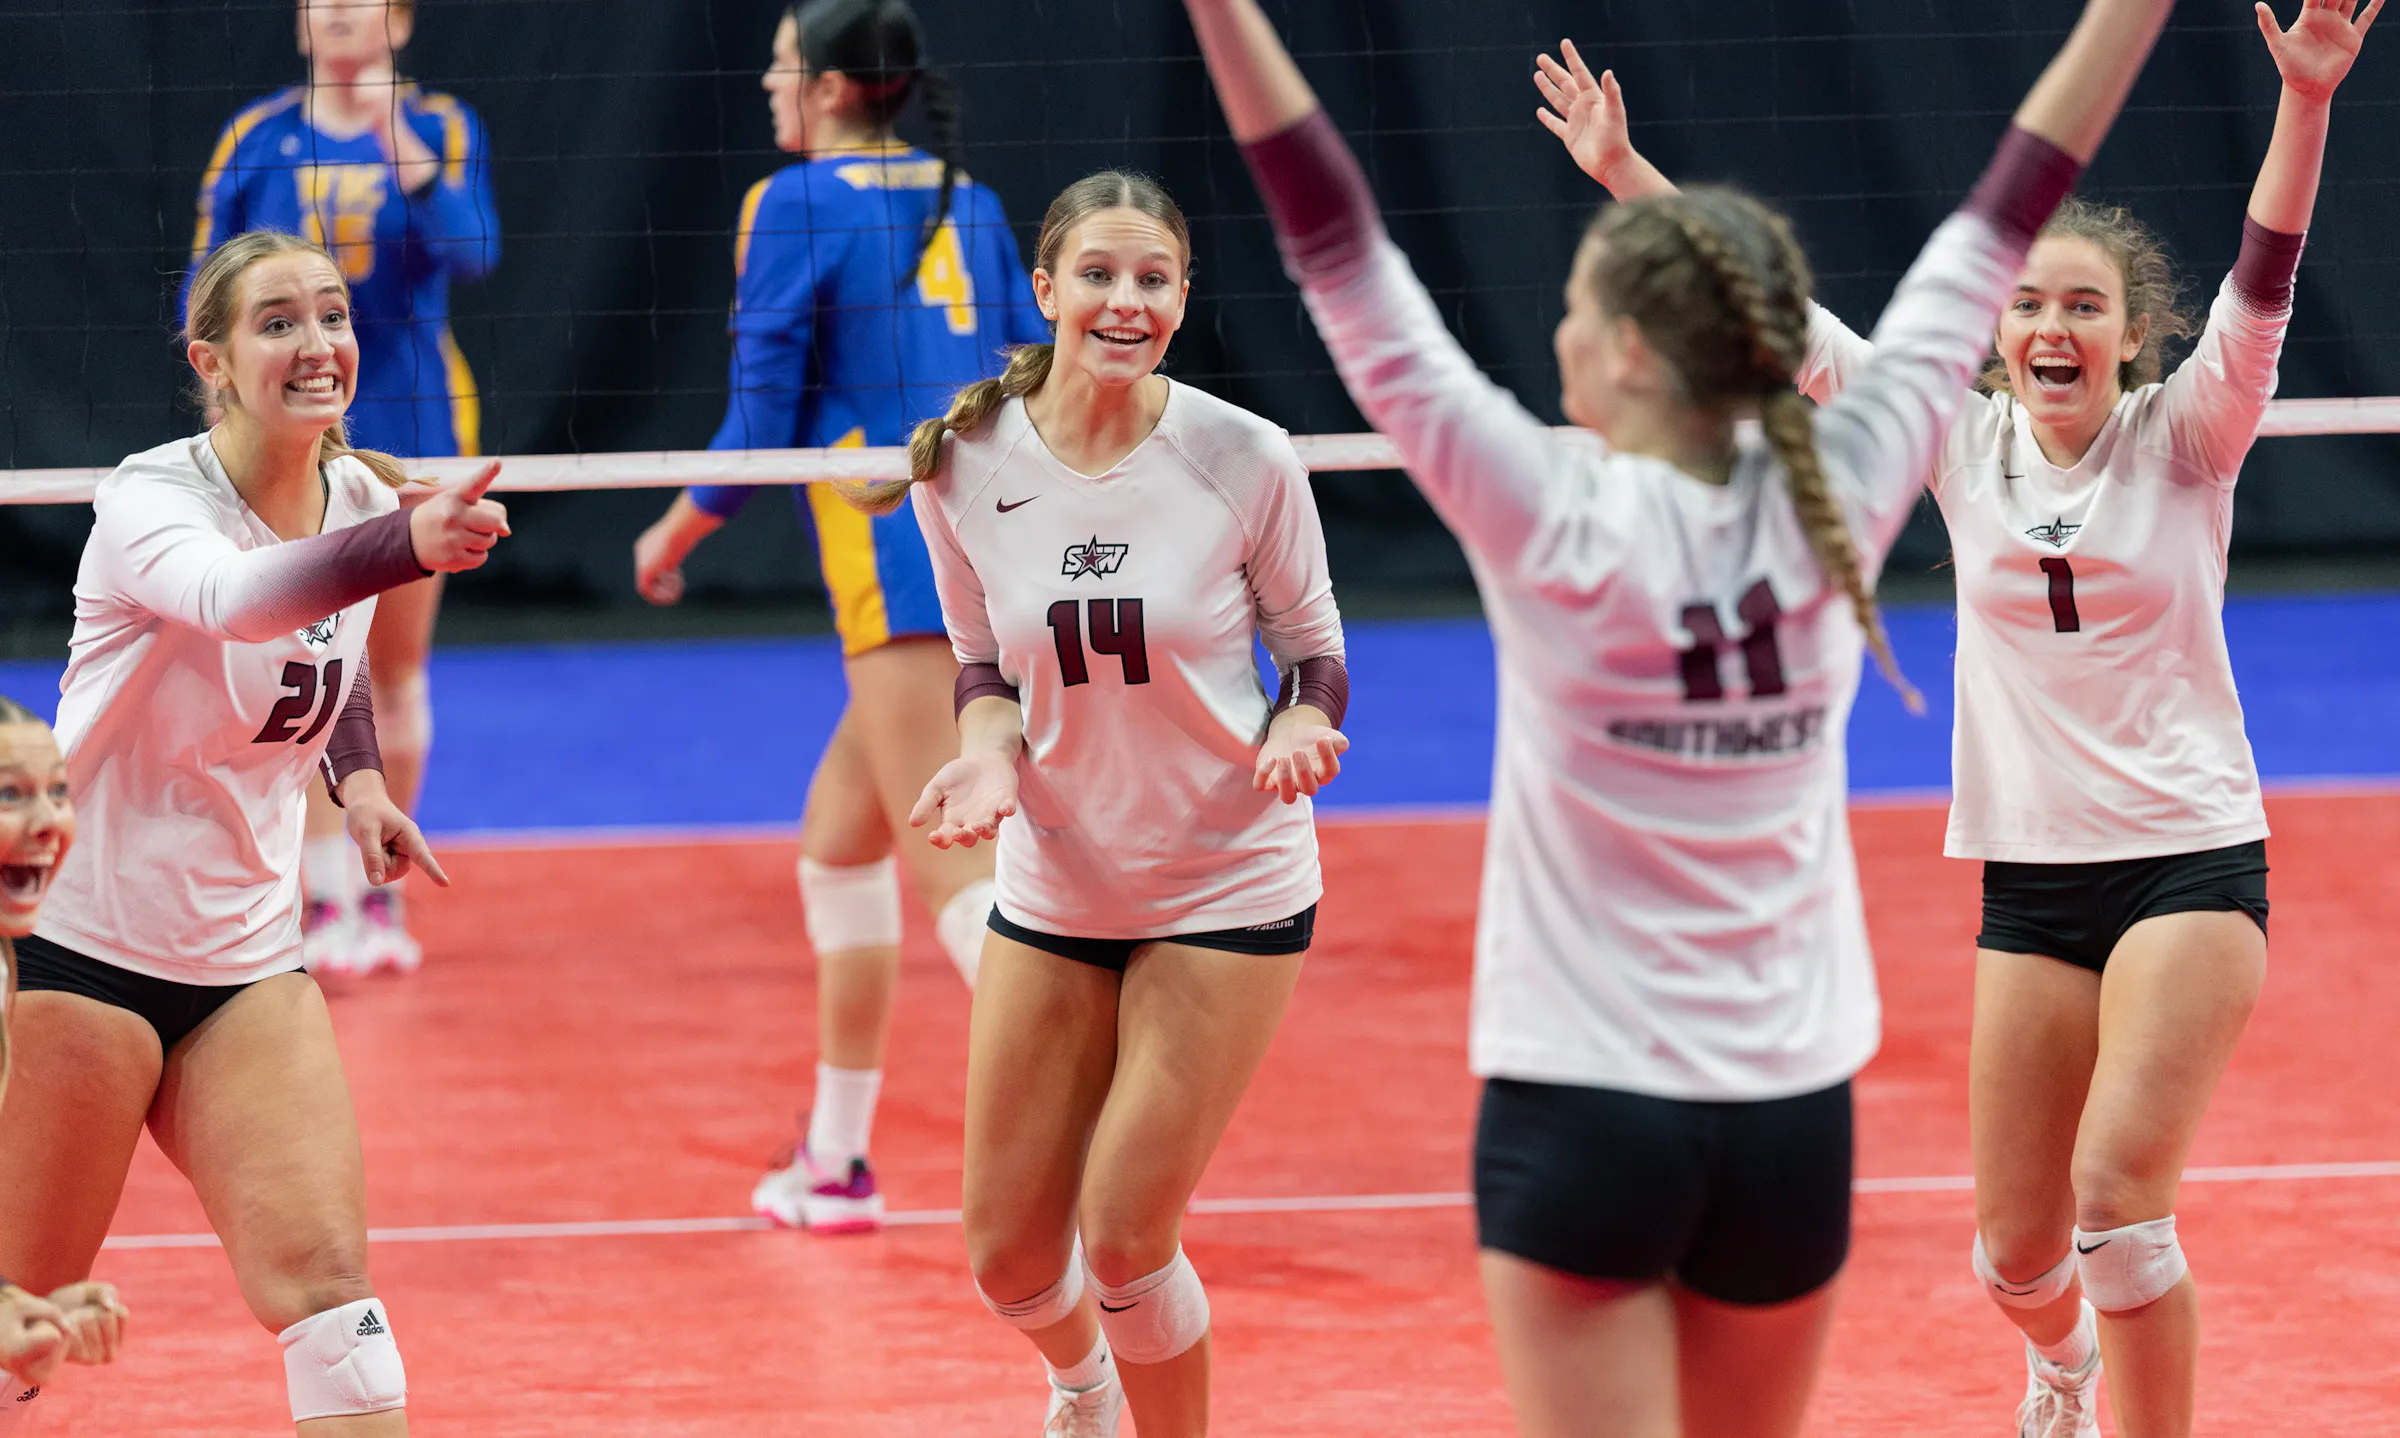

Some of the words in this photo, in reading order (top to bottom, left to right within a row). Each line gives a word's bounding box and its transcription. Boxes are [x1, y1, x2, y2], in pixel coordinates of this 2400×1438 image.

[916, 215, 978, 336] 4
[1061, 541, 1129, 579] SW
[2038, 557, 2080, 633] 1
[1047, 598, 1151, 688] 14
[1677, 576, 1789, 703] 11
[250, 657, 343, 745] 21
[356, 1325, 385, 1336] adidas
